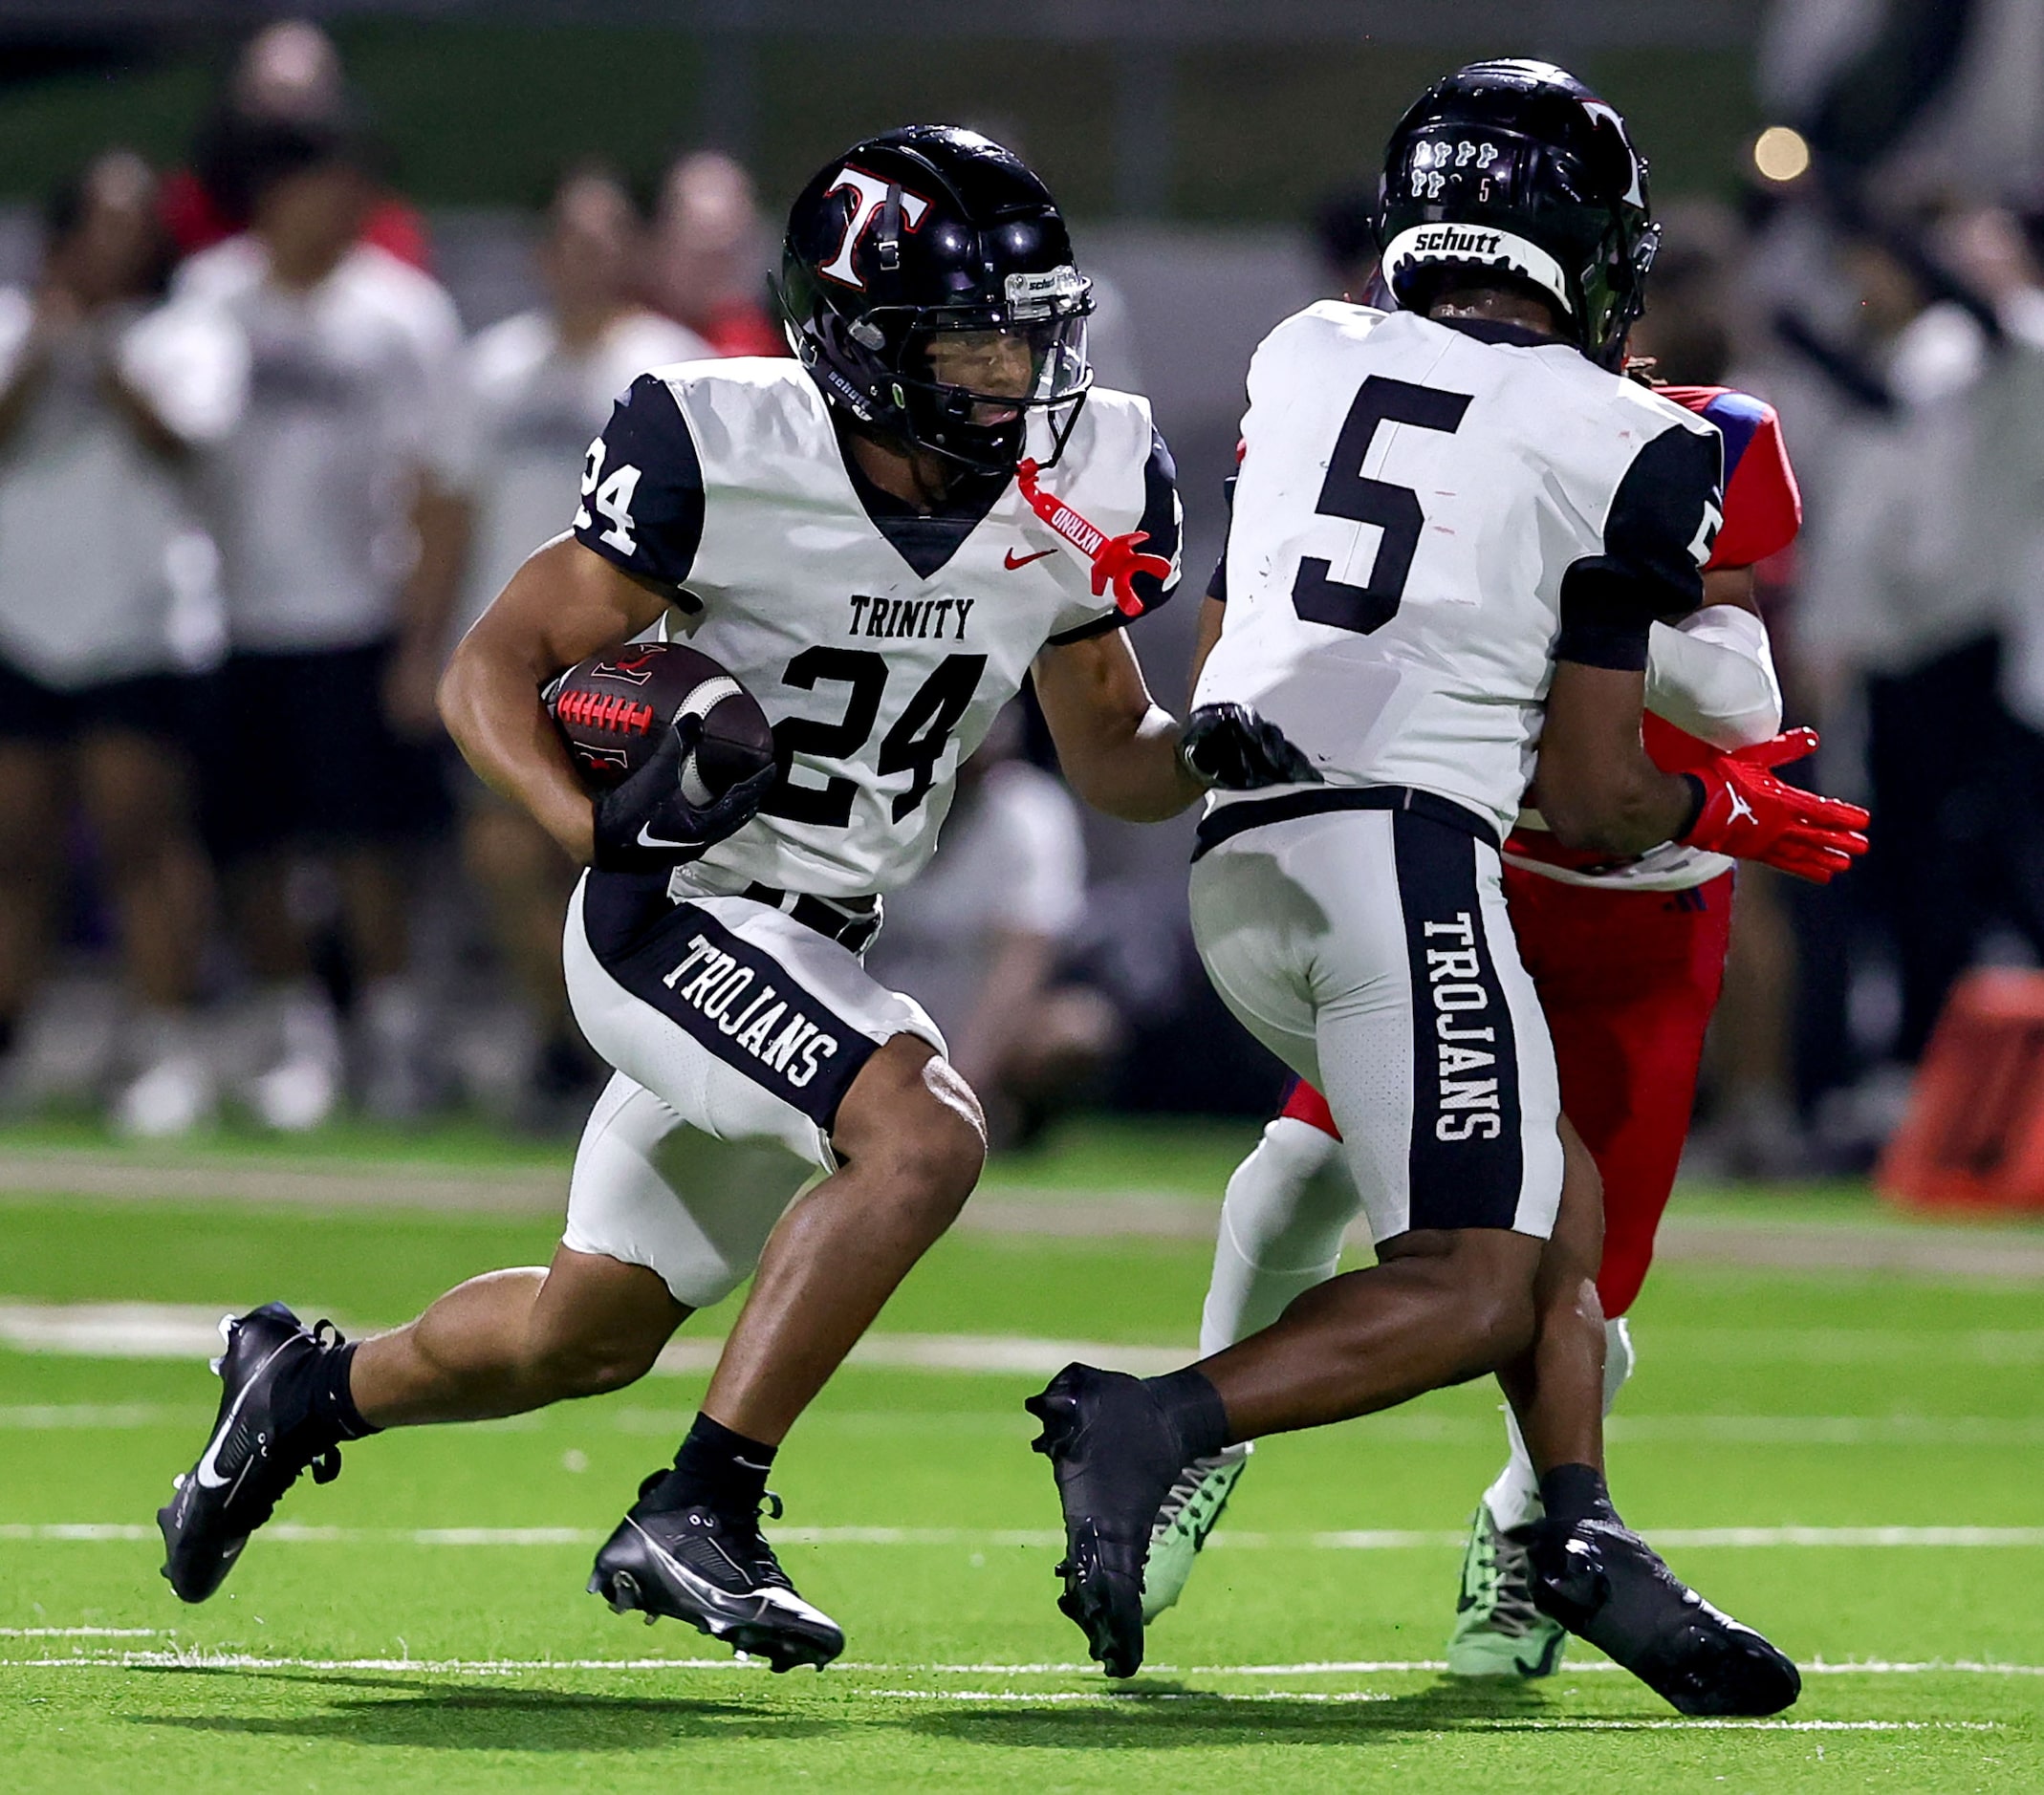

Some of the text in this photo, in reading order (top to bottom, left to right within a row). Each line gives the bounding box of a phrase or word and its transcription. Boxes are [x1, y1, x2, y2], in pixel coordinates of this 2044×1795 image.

[818, 163, 934, 292] T
[1414, 227, 1501, 254] schutt
[1479, 178, 1490, 203] 5
[573, 436, 641, 556] 24
[1052, 507, 1103, 555] NXTRND
[1291, 374, 1475, 636] 5
[849, 595, 974, 639] TRINITY
[758, 645, 989, 828] 24
[663, 934, 838, 1088] TROJANS
[1424, 911, 1501, 1141] TROJANS
